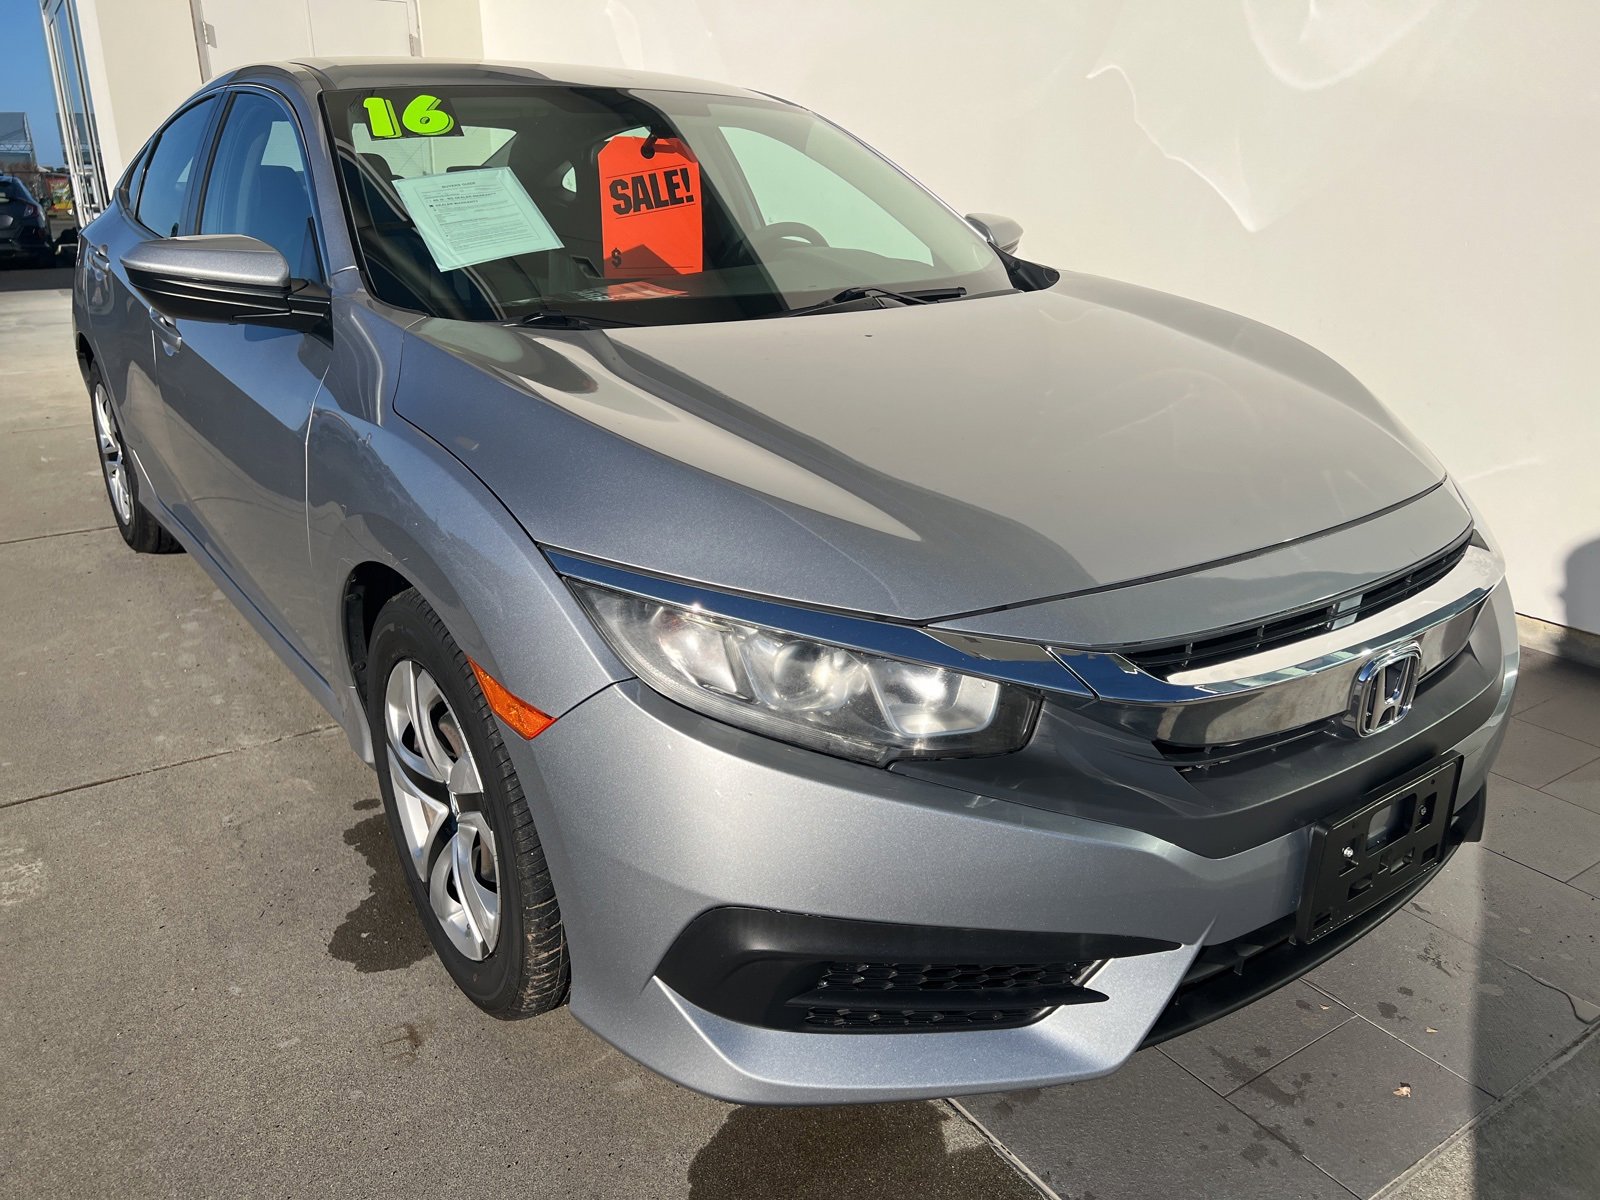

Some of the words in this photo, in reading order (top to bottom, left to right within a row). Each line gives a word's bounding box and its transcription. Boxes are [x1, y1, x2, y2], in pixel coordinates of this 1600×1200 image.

[363, 94, 454, 138] 16
[609, 168, 695, 215] SALE!
[611, 247, 622, 268] $
